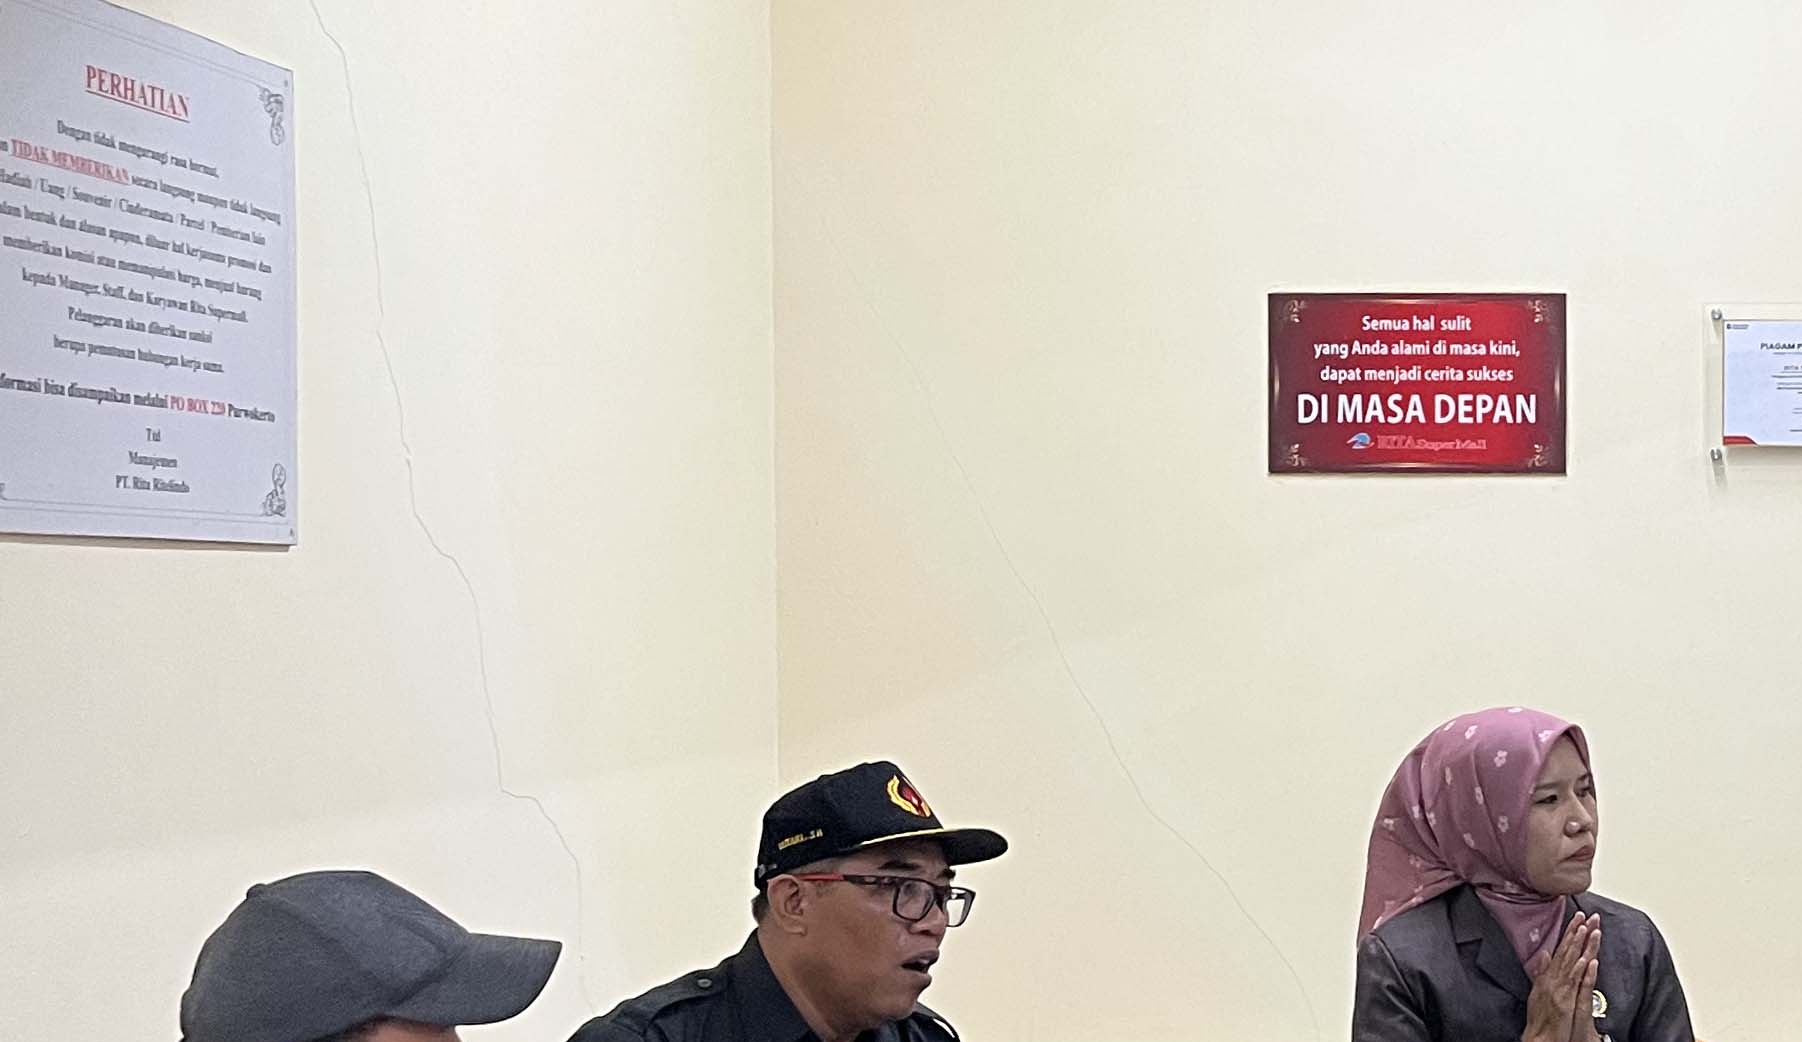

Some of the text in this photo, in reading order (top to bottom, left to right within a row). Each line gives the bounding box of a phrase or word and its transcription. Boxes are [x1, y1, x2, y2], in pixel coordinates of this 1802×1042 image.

[86, 64, 190, 118] PERHATIAN
[11, 139, 48, 161] TIDAK
[52, 149, 129, 182] MEMBERIKAN
[1361, 315, 1472, 332] Semua hal sulit
[1314, 340, 1521, 359] yang Anda alami di masa kini,
[1760, 342, 1795, 350] PIAGAM
[1320, 366, 1514, 385] dapat menjadi cerita sukses
[170, 395, 185, 411] PO
[187, 397, 208, 414] BOX
[1297, 394, 1537, 424] DI MASA DEPAN
